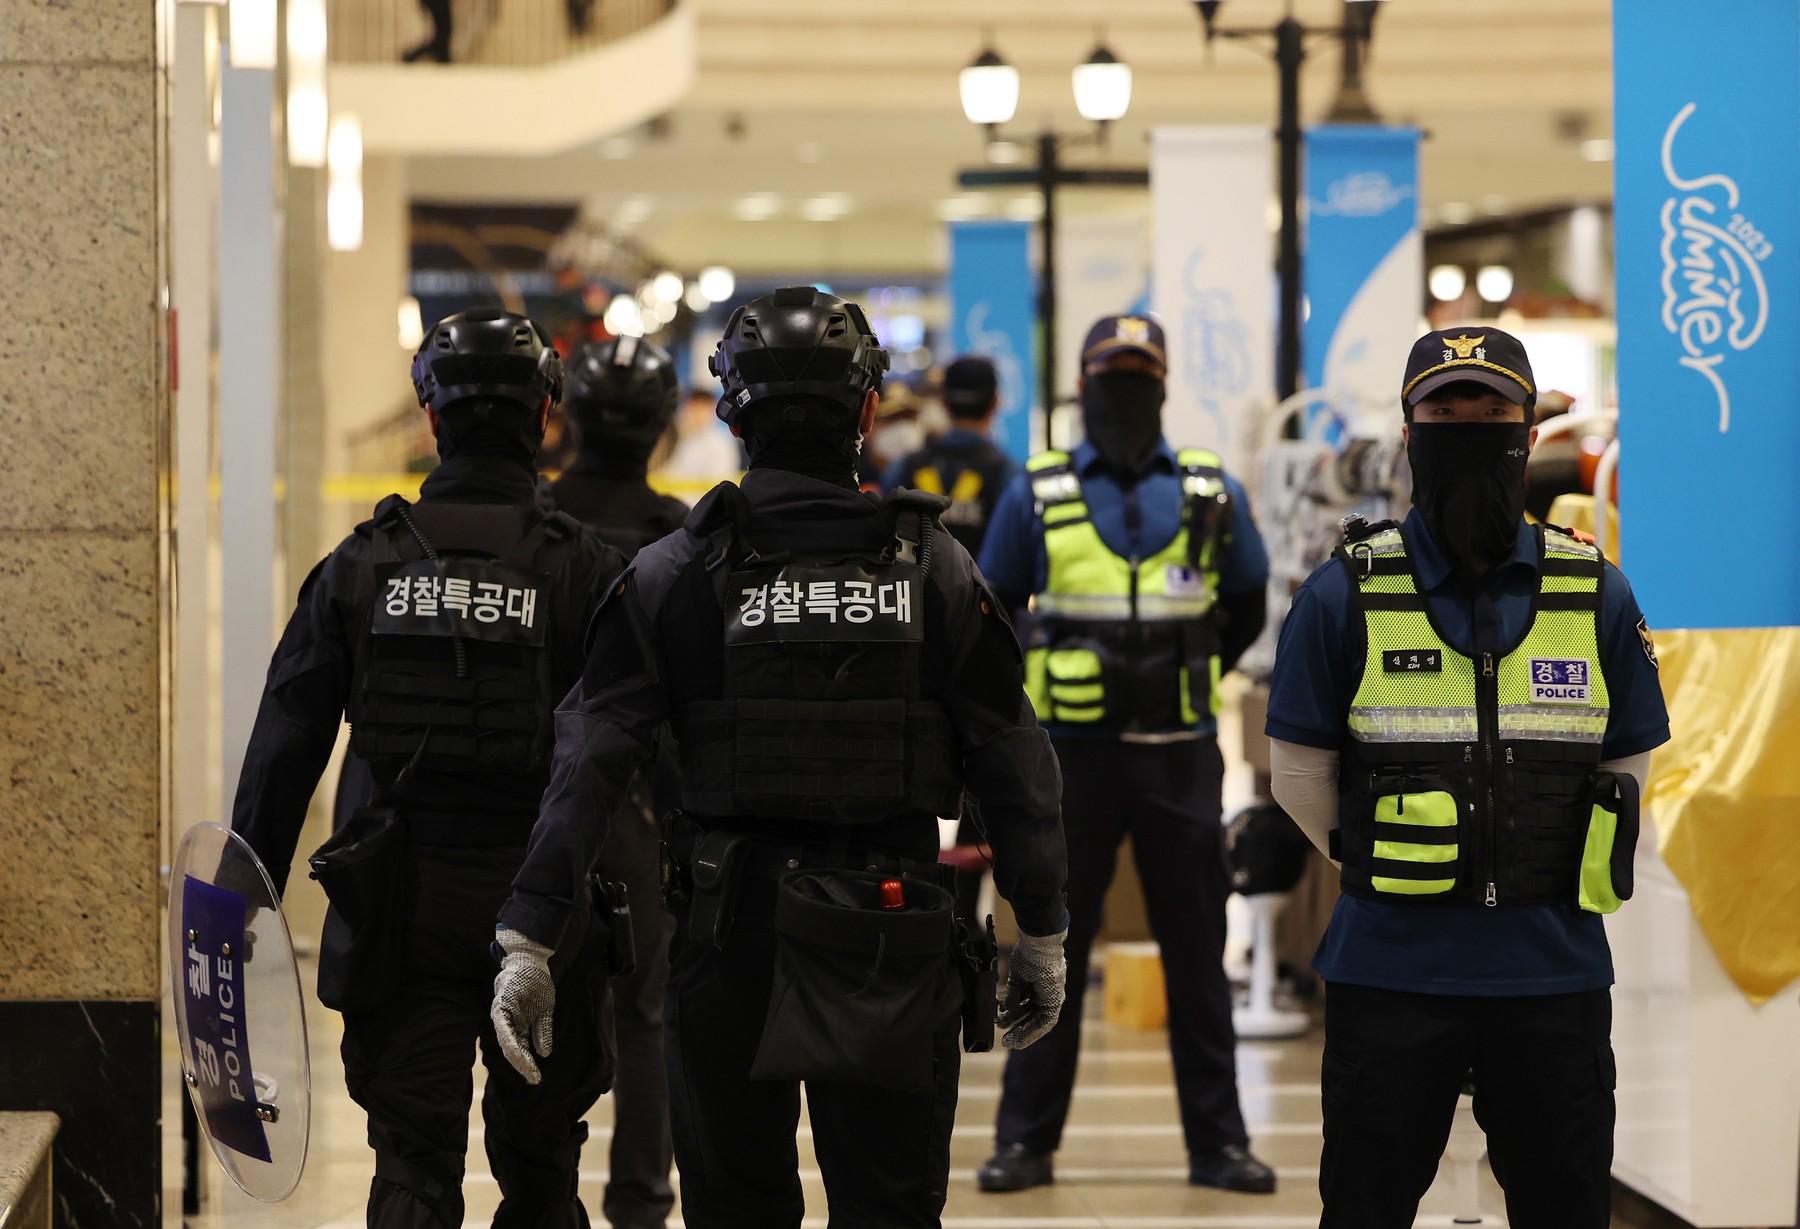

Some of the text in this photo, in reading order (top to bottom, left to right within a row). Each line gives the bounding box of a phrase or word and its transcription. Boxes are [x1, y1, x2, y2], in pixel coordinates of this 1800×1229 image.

[1727, 213, 1773, 261] 2023
[385, 576, 537, 628] 경찰특공대
[739, 580, 912, 627] 경찰특공대
[1536, 688, 1585, 699] POLICE
[217, 956, 246, 1102] POLICE
